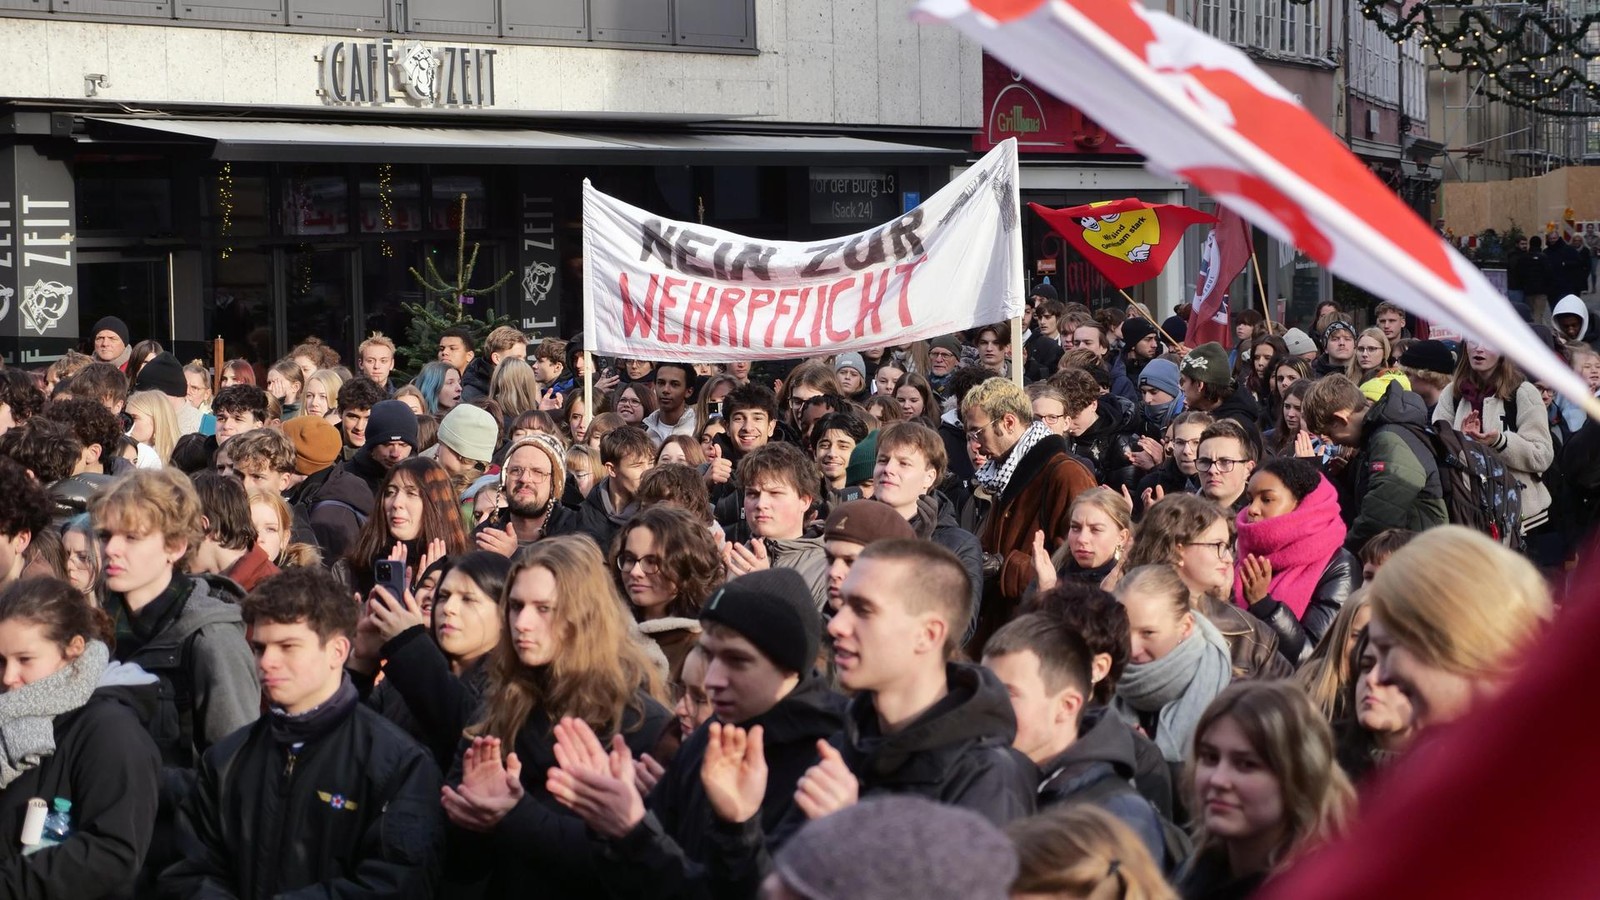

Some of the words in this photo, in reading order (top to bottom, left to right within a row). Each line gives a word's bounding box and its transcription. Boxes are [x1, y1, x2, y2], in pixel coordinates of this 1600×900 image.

[444, 46, 498, 106] ZEIT
[852, 178, 878, 198] Burg
[881, 174, 895, 194] 13
[22, 195, 72, 267] ZEIT
[523, 193, 555, 251] ZEIT
[640, 216, 777, 281] NEIN
[800, 207, 926, 279] ZUR
[1111, 224, 1126, 240] sind
[1129, 216, 1146, 234] stark
[618, 252, 928, 349] WEHRPFLICHT
